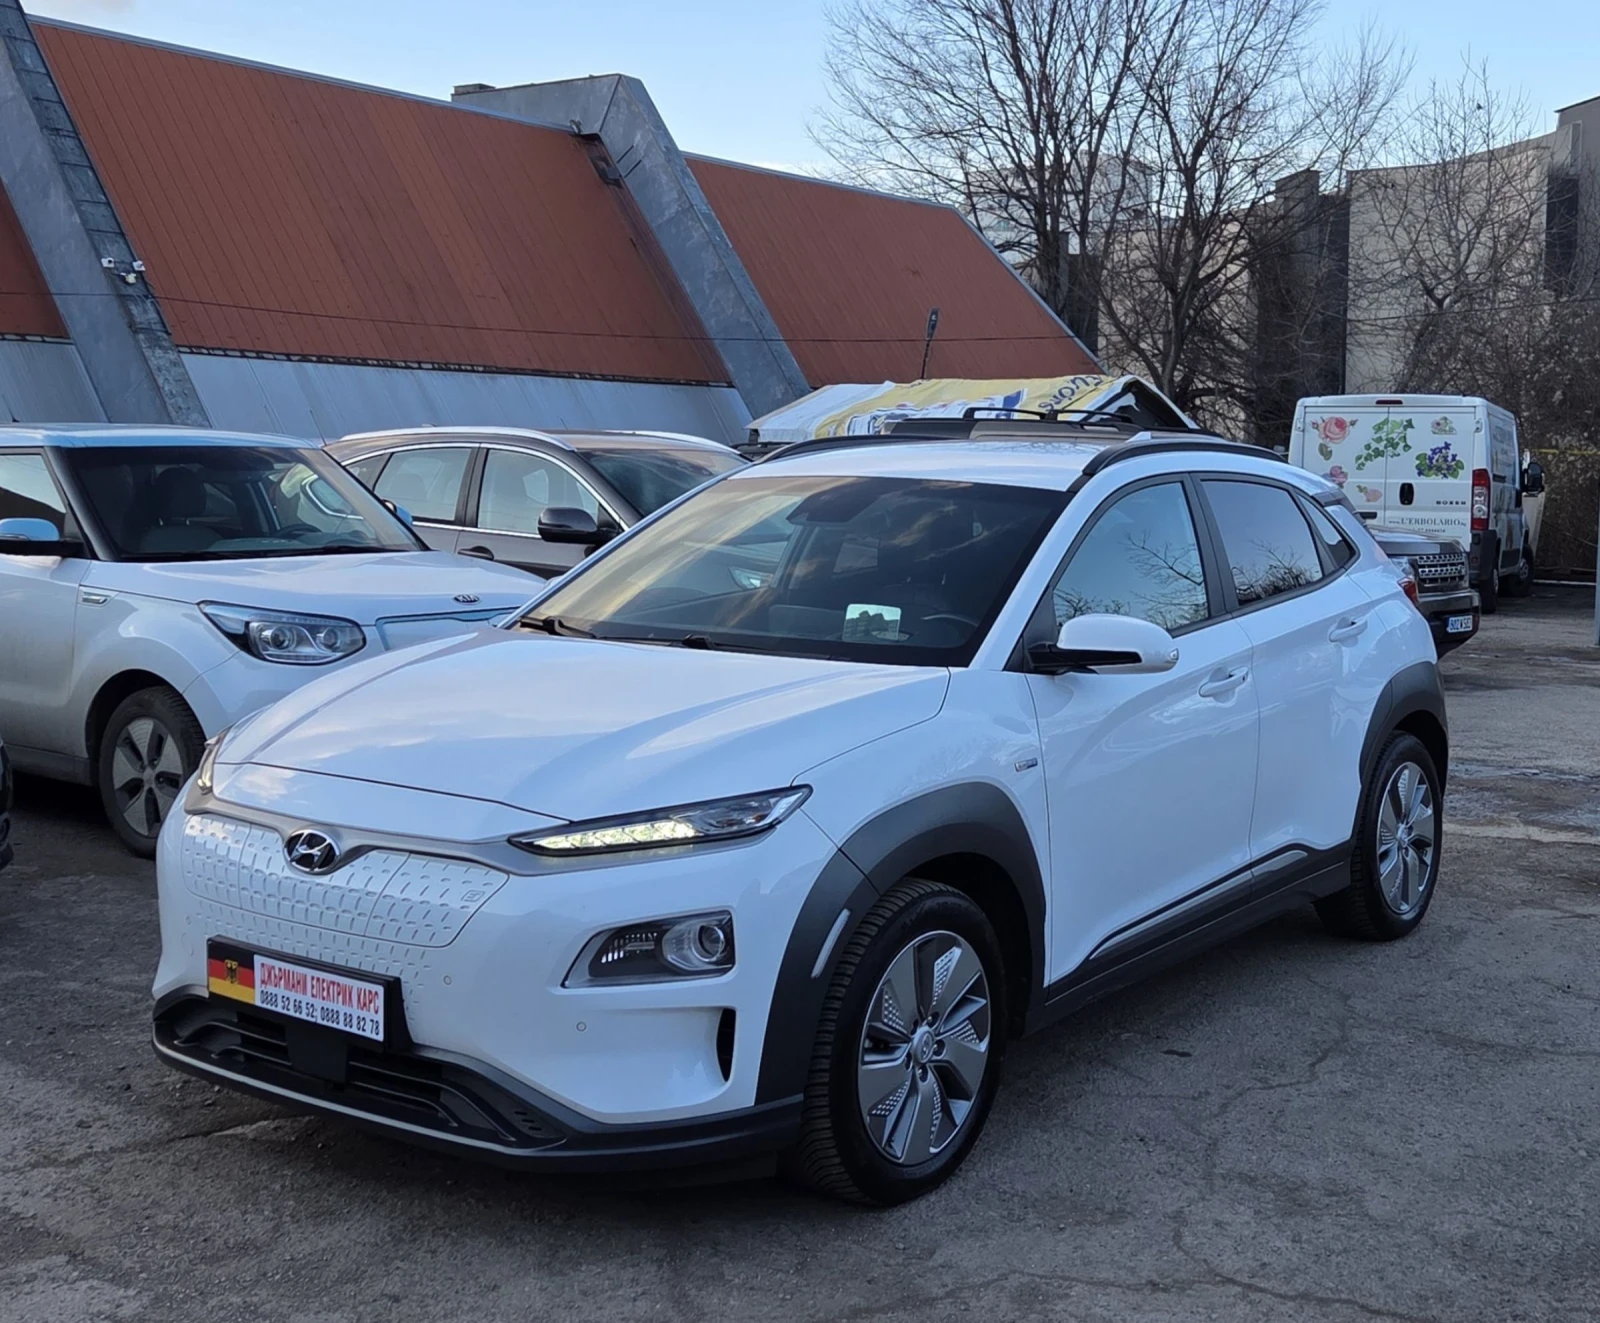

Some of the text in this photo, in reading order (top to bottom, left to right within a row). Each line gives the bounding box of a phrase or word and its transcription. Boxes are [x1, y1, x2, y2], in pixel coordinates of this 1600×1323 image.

[456, 594, 479, 602] KIA
[260, 962, 379, 1015] ДЖЪРМАНИ ЕЛЕКТРИК КАРС
[260, 989, 278, 1008] 0888
[281, 995, 290, 1011] 52
[293, 998, 303, 1015] 66
[321, 1006, 340, 1025] 0888
[343, 1012, 353, 1029] 88
[356, 1015, 366, 1032] 82
[370, 1019, 380, 1036] 78
